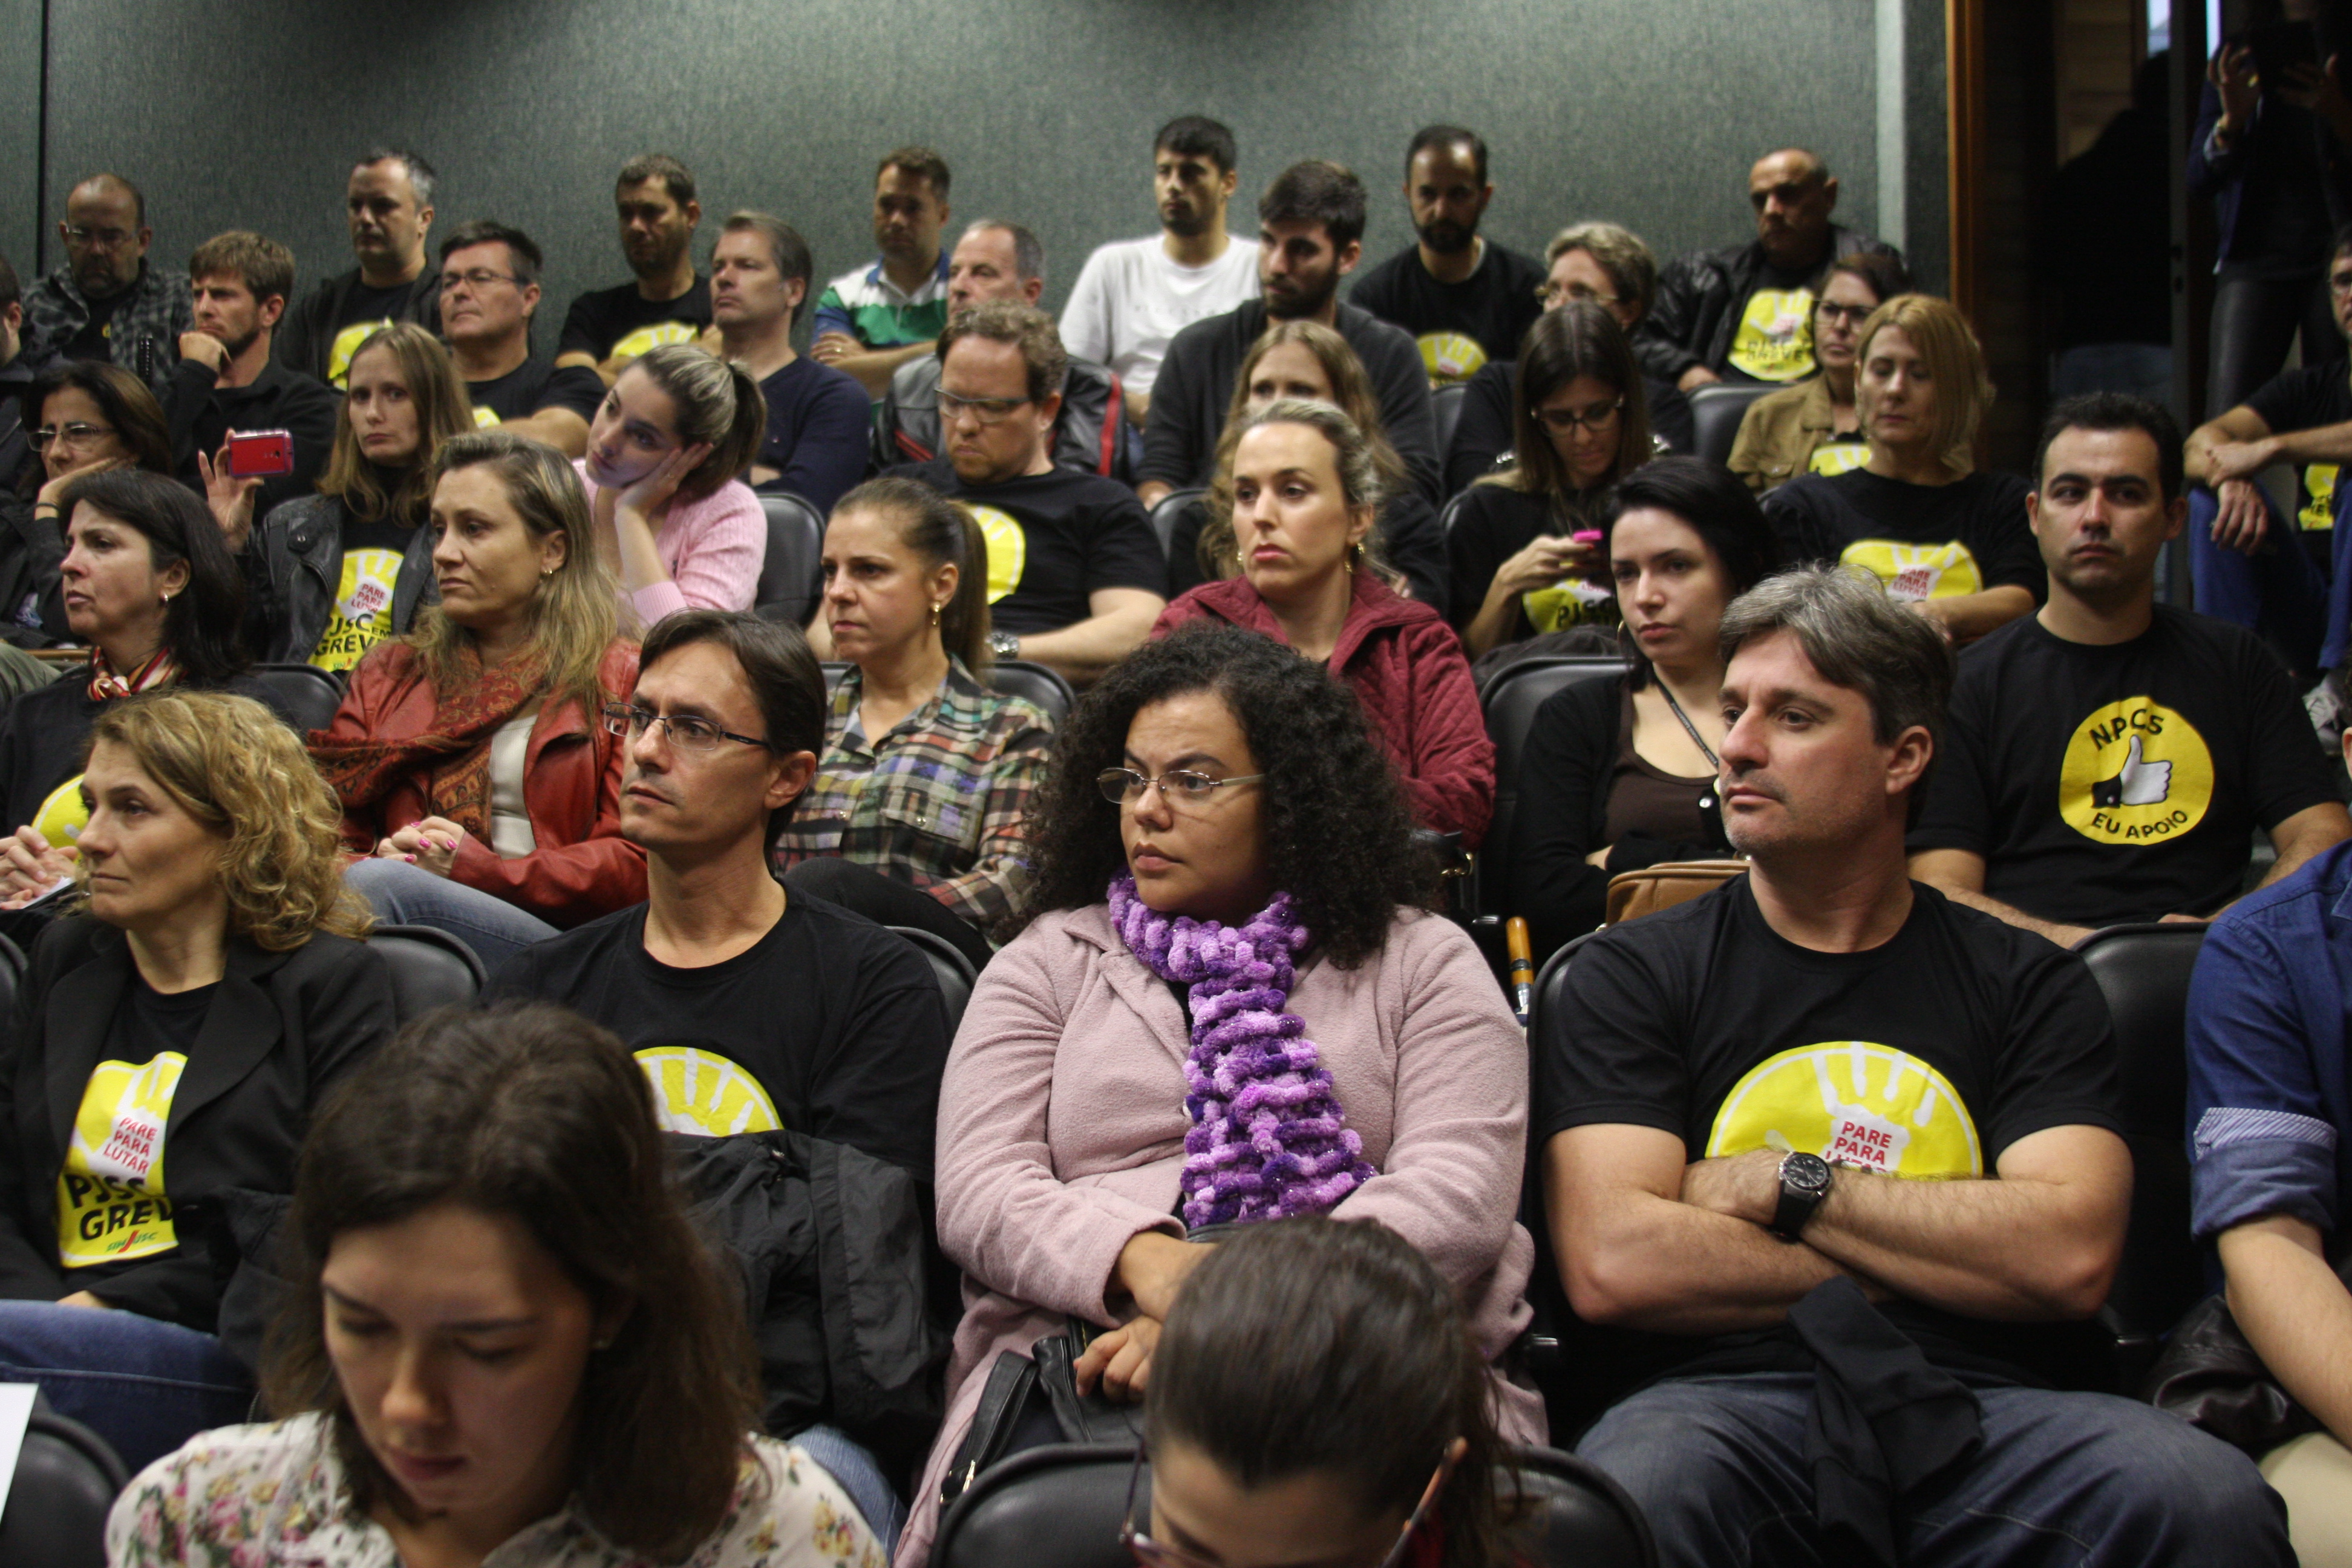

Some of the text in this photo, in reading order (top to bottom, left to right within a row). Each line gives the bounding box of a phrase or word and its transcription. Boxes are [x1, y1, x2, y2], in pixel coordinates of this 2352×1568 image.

[358, 591, 382, 607] PARA
[362, 583, 386, 598] PARE
[315, 633, 380, 656] GREV
[2089, 708, 2164, 751] NPCS
[2091, 810, 2189, 839] EU APOIO
[113, 1130, 151, 1157] PARA
[119, 1117, 158, 1142] PARE
[1840, 1120, 1893, 1149] PARE
[103, 1143, 150, 1174] LUTAR
[1833, 1136, 1885, 1165] PARA
[80, 1198, 174, 1241] GREV
